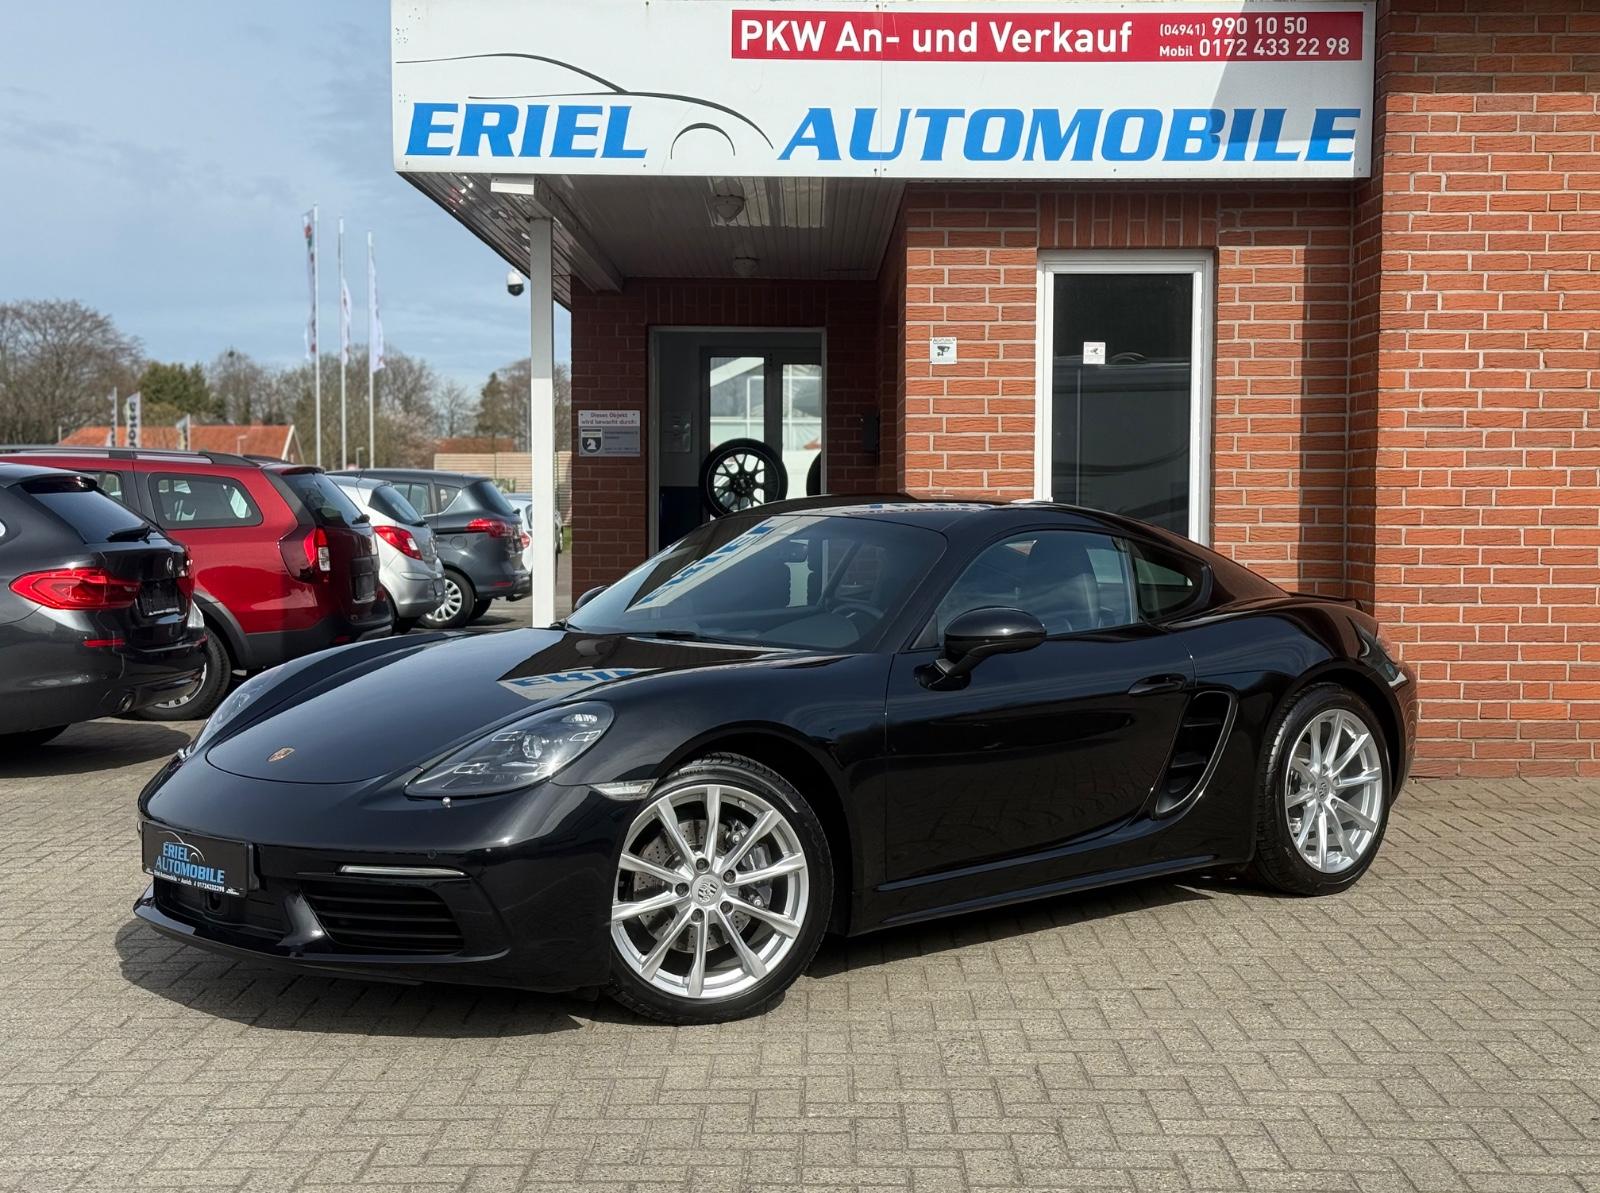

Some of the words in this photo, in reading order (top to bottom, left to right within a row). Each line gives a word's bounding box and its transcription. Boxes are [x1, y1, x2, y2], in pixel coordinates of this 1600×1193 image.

[740, 20, 826, 52] PKW
[835, 22, 900, 52] An-
[912, 22, 978, 53] und
[989, 22, 1133, 53] Verkauf
[1159, 23, 1206, 37] (04941)
[1211, 17, 1248, 36] 990
[1255, 17, 1277, 35] 10
[1284, 17, 1308, 35] 50
[1159, 45, 1194, 57] Mobil
[1199, 39, 1248, 57] 0172
[1253, 38, 1290, 56] 433
[1296, 38, 1320, 56] 22
[1326, 38, 1350, 56] 98
[404, 102, 648, 159] ERIEL
[777, 107, 1361, 162] AUTOMOBILE
[163, 843, 189, 862] ERIEL
[155, 856, 225, 883] AUTOMOBILE
